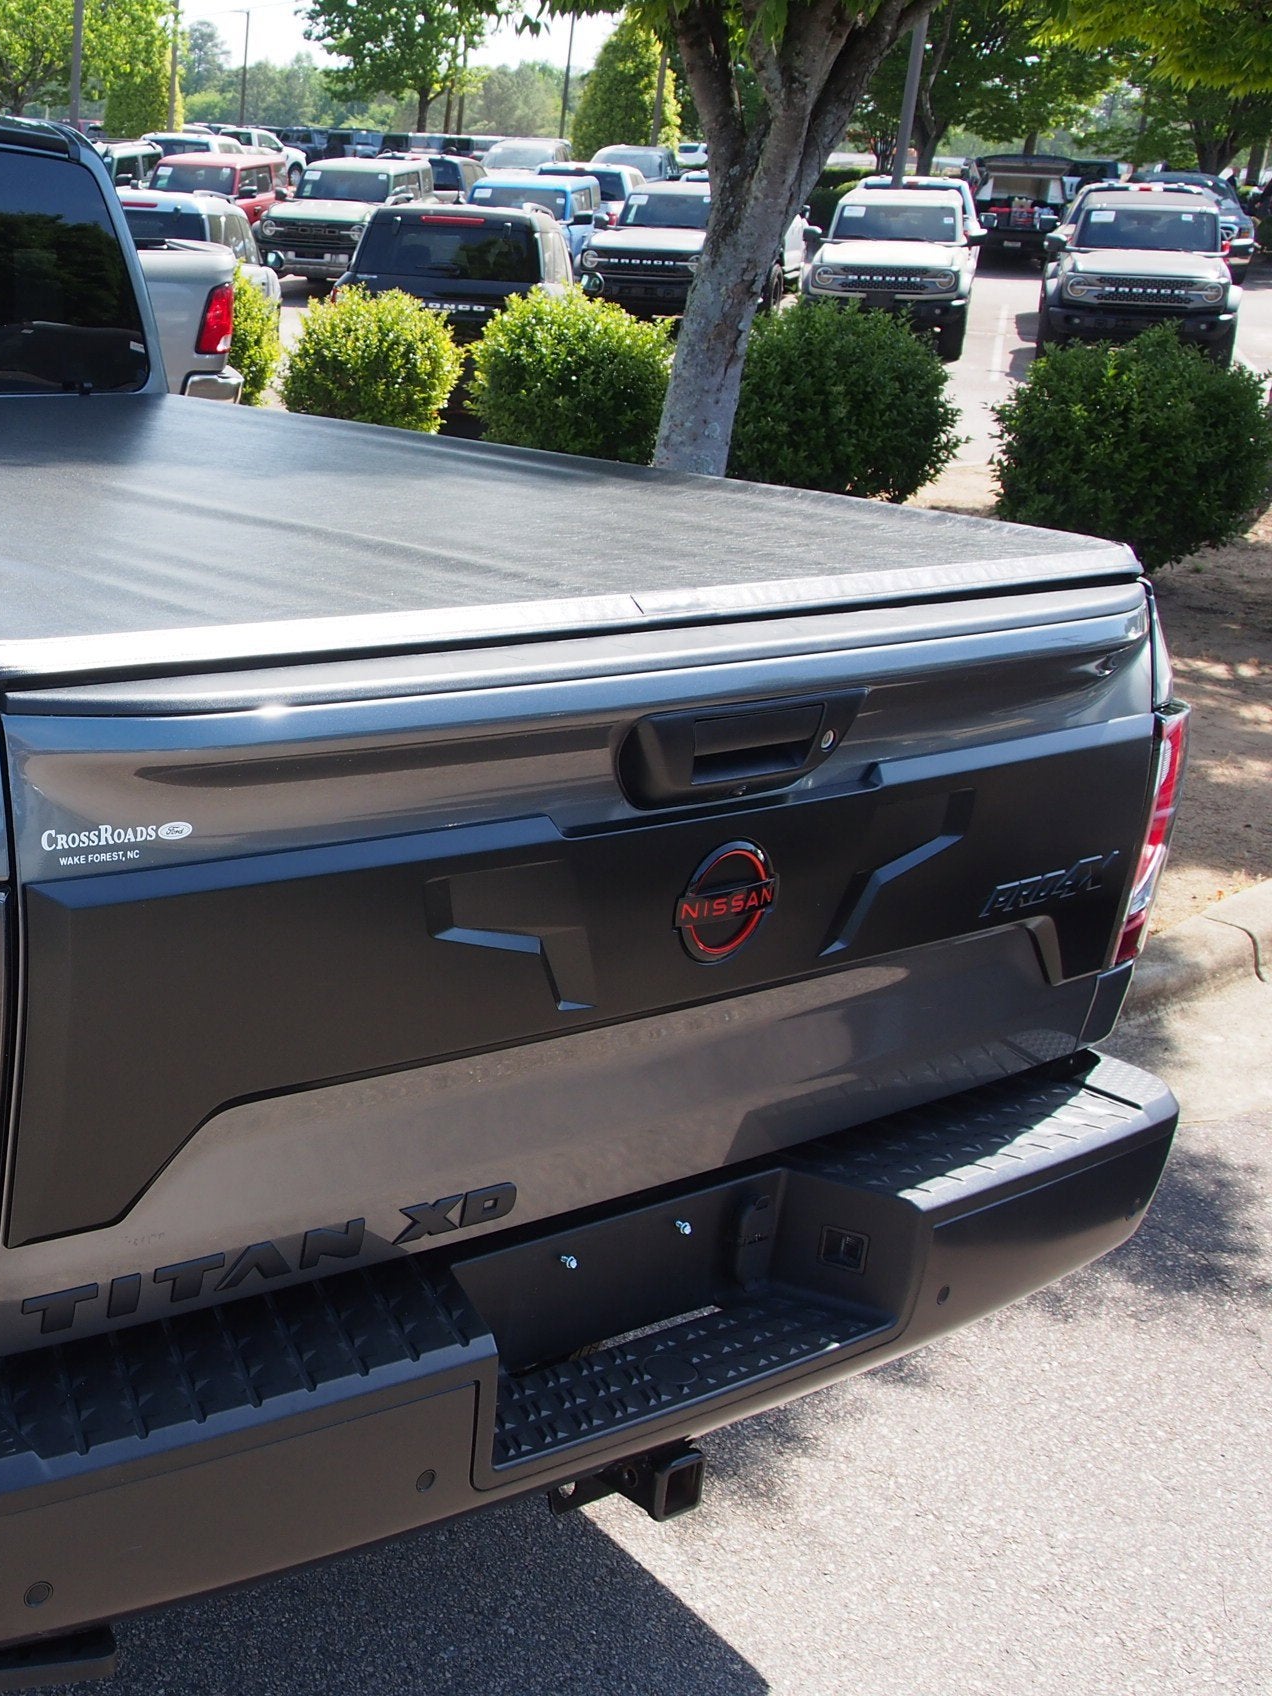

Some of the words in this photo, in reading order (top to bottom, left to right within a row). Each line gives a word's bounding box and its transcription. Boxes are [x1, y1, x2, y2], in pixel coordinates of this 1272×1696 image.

[609, 257, 674, 266] BRONCO
[848, 274, 921, 282] BRONCO
[1104, 286, 1186, 295] BRONCO
[420, 301, 486, 312] ONCO
[58, 855, 86, 867] WAKE
[88, 851, 126, 864] FOREST,
[127, 849, 141, 859] NC
[680, 884, 776, 920] NISSAN
[20, 1216, 367, 1335] TITAN
[391, 1181, 519, 1246] XD
